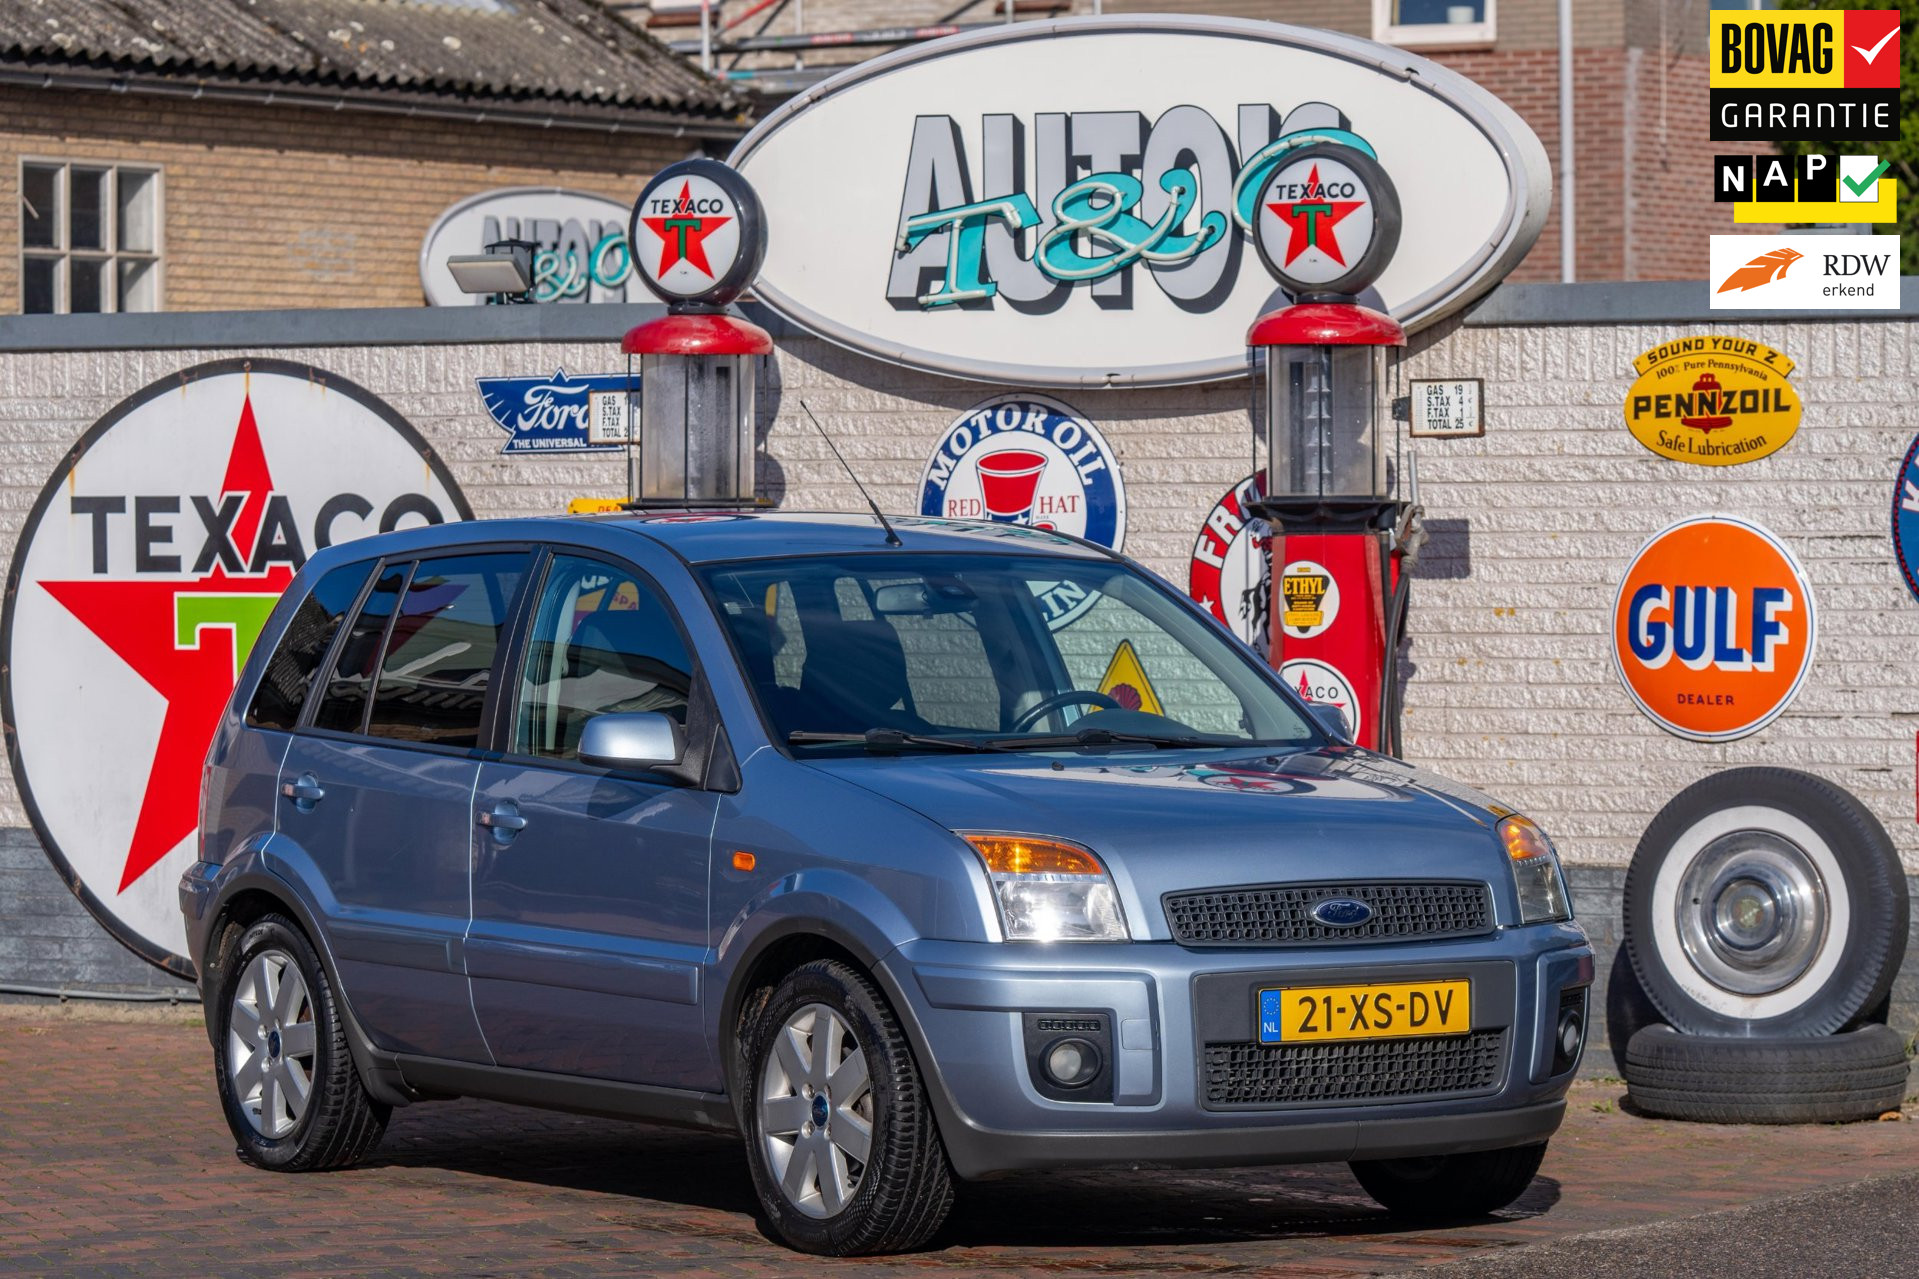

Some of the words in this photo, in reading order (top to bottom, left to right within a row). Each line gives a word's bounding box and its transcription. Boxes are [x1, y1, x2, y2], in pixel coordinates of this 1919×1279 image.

[1276, 182, 1356, 200] TEXACO
[651, 198, 724, 214] TEXACO
[1647, 338, 1704, 364] SOUND
[1711, 338, 1757, 356] YOUR
[1764, 350, 1778, 365] Z
[1684, 361, 1706, 372] Pure
[1708, 359, 1768, 381] Pennsylvania
[1426, 384, 1444, 396] GAS
[1454, 384, 1463, 395] 19
[602, 394, 616, 406] GAS
[1426, 396, 1451, 407] S.TAX
[1458, 397, 1464, 406] 4
[1633, 388, 1792, 420] PENNZOIL
[602, 406, 621, 417] S.TAX
[1427, 407, 1450, 418] F.TAX
[602, 417, 620, 427] F.TAX
[1427, 418, 1452, 430] TOTAL
[1455, 418, 1465, 429] 25
[602, 427, 621, 438] TOTAL
[512, 438, 532, 449] THE
[533, 437, 587, 449] UNIVERSAL
[928, 403, 1049, 491] MOTOR
[1053, 421, 1107, 486] OIL
[1656, 429, 1686, 452] Safe
[1689, 434, 1767, 456] Lubrication
[948, 498, 981, 517] RED
[1039, 494, 1080, 514] HAT
[1284, 577, 1326, 595] ETHYL
[1628, 584, 1793, 673] GULF
[1677, 693, 1735, 706] DEALER
[1263, 1022, 1279, 1034] NL
[1298, 989, 1454, 1033] 21-XS-DV
